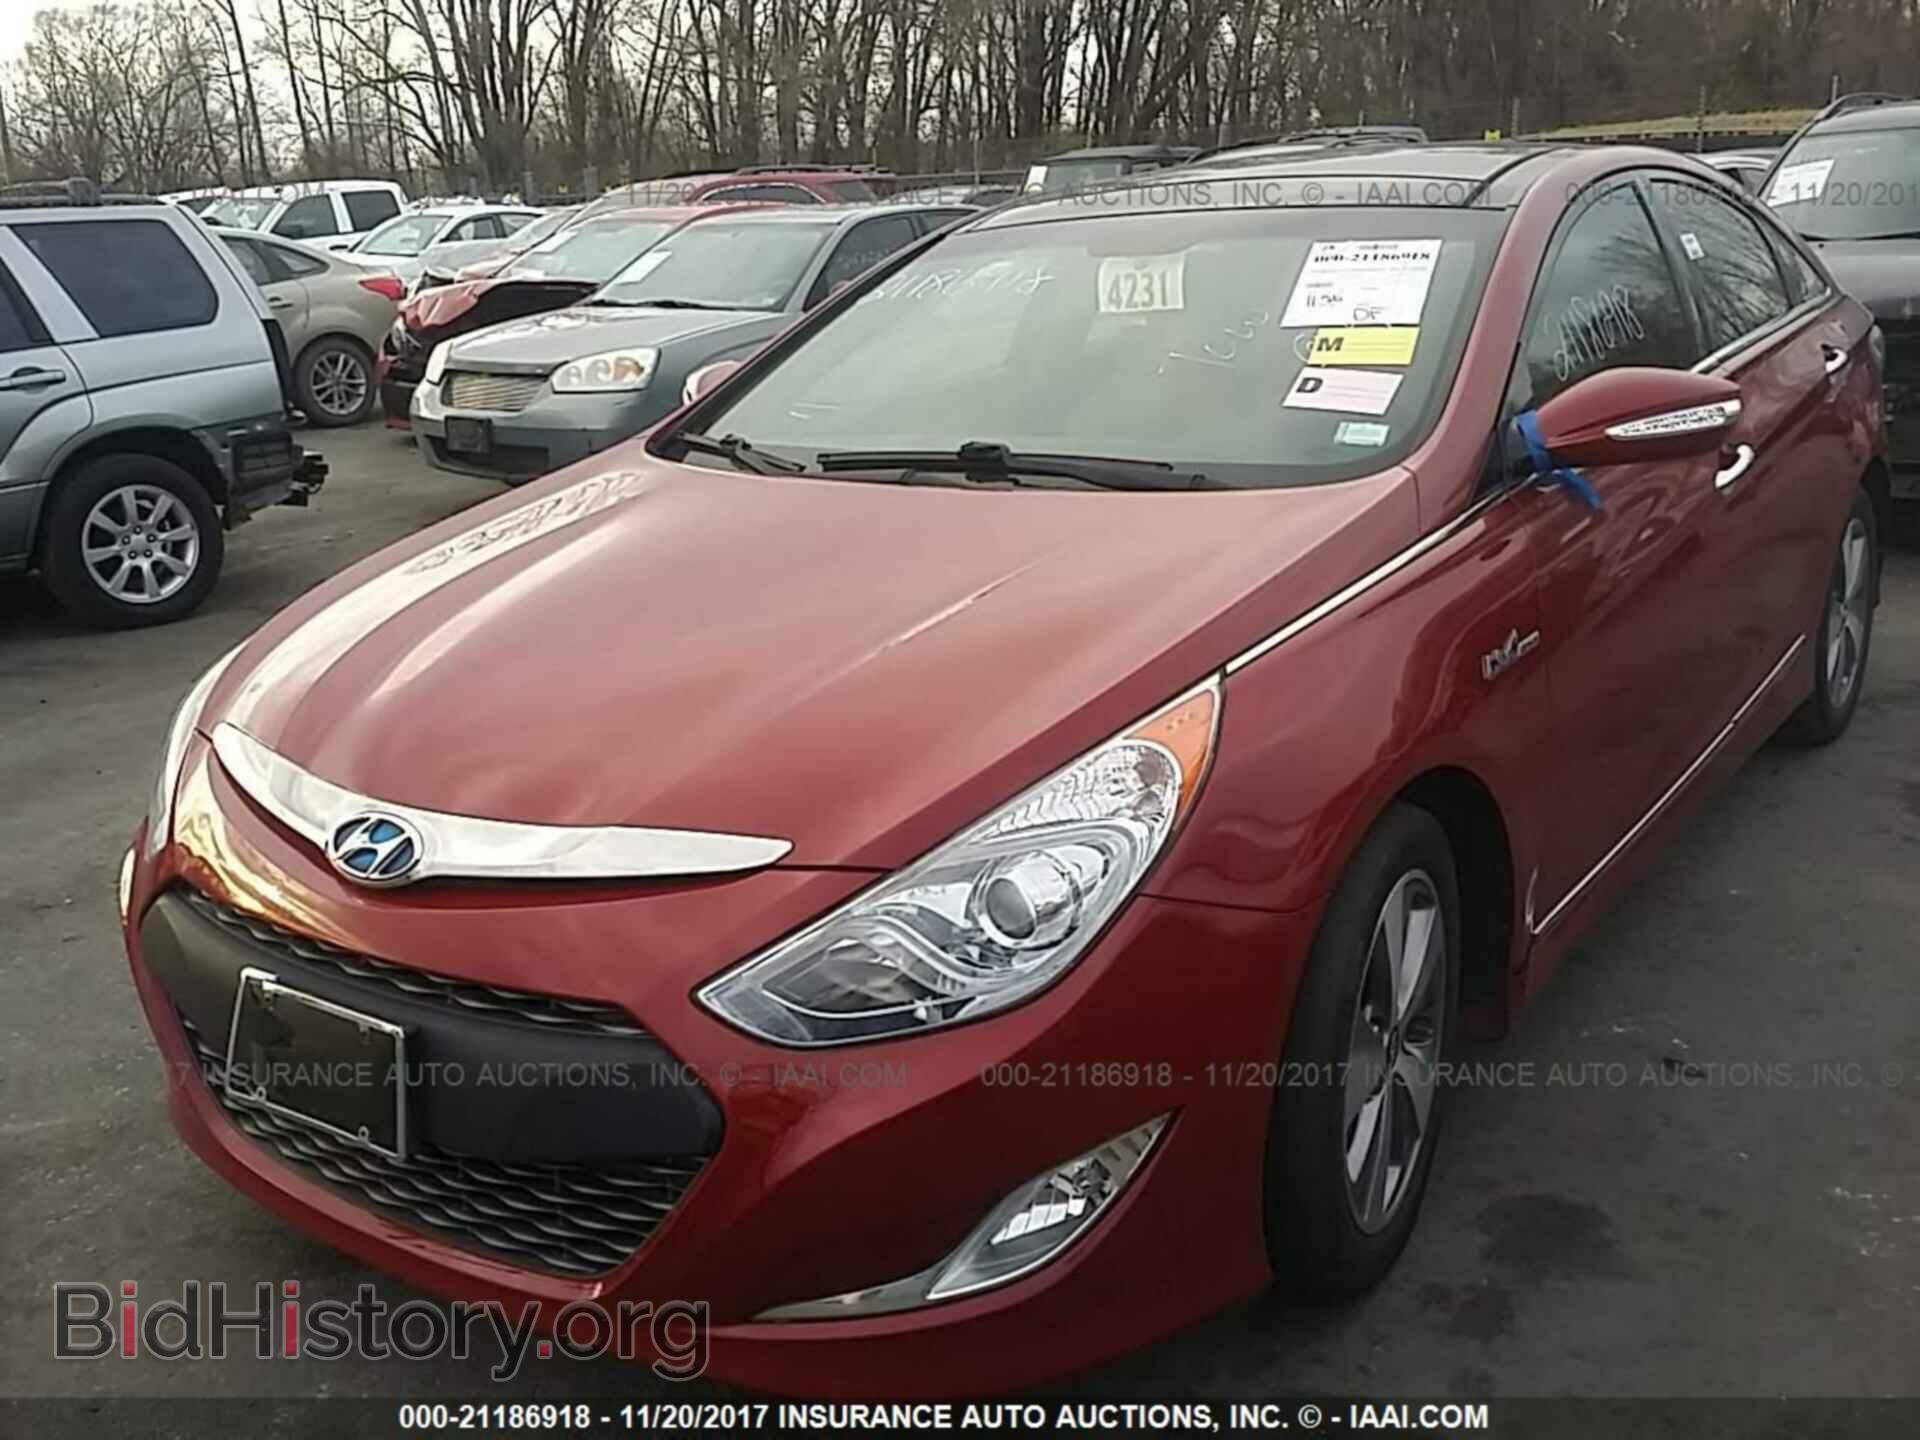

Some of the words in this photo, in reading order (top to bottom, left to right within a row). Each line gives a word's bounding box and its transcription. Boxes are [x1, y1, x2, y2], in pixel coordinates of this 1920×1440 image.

[1106, 270, 1169, 308] 4231
[1316, 336, 1344, 352] M
[1295, 376, 1323, 393] D
